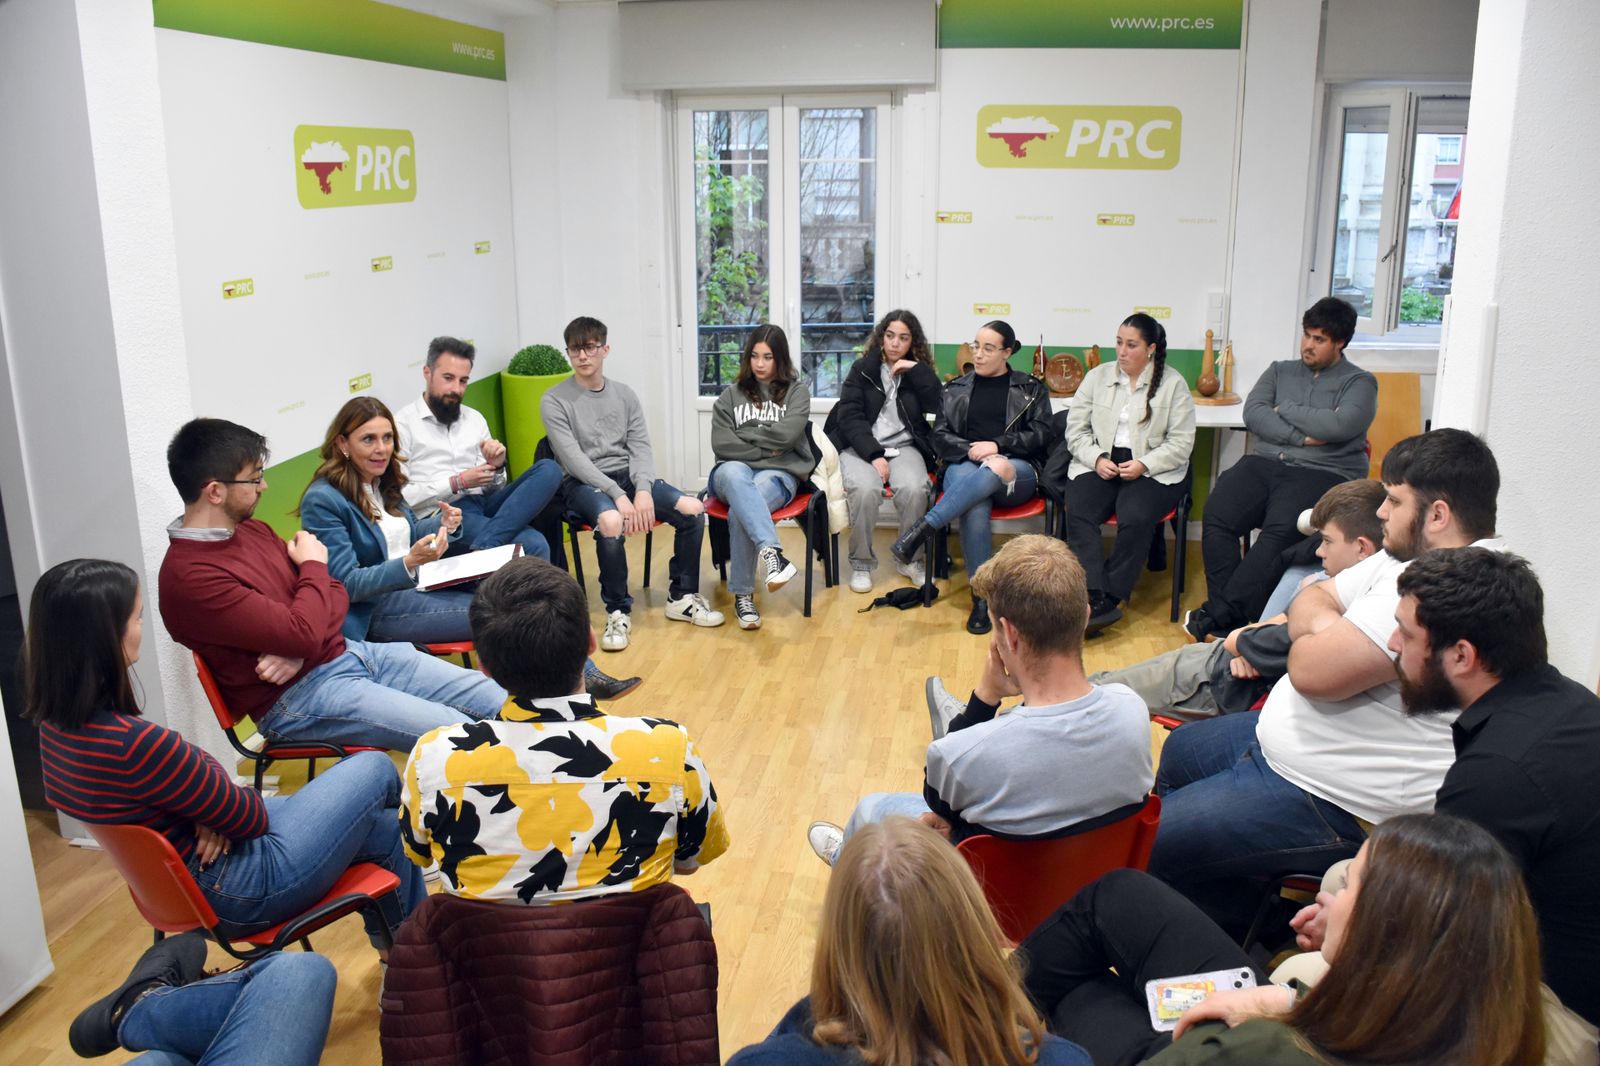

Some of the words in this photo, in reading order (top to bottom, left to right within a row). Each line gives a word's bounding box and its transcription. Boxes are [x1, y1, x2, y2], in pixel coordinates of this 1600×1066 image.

[1110, 16, 1215, 31] www.prc.es
[451, 41, 496, 60] www.prc.es
[1064, 119, 1172, 159] PRC
[355, 145, 411, 191] PRC
[951, 213, 970, 223] PRC
[1112, 215, 1133, 225] PRC
[236, 282, 252, 295] PRC
[990, 305, 1009, 314] PRC
[358, 376, 370, 387] PRC
